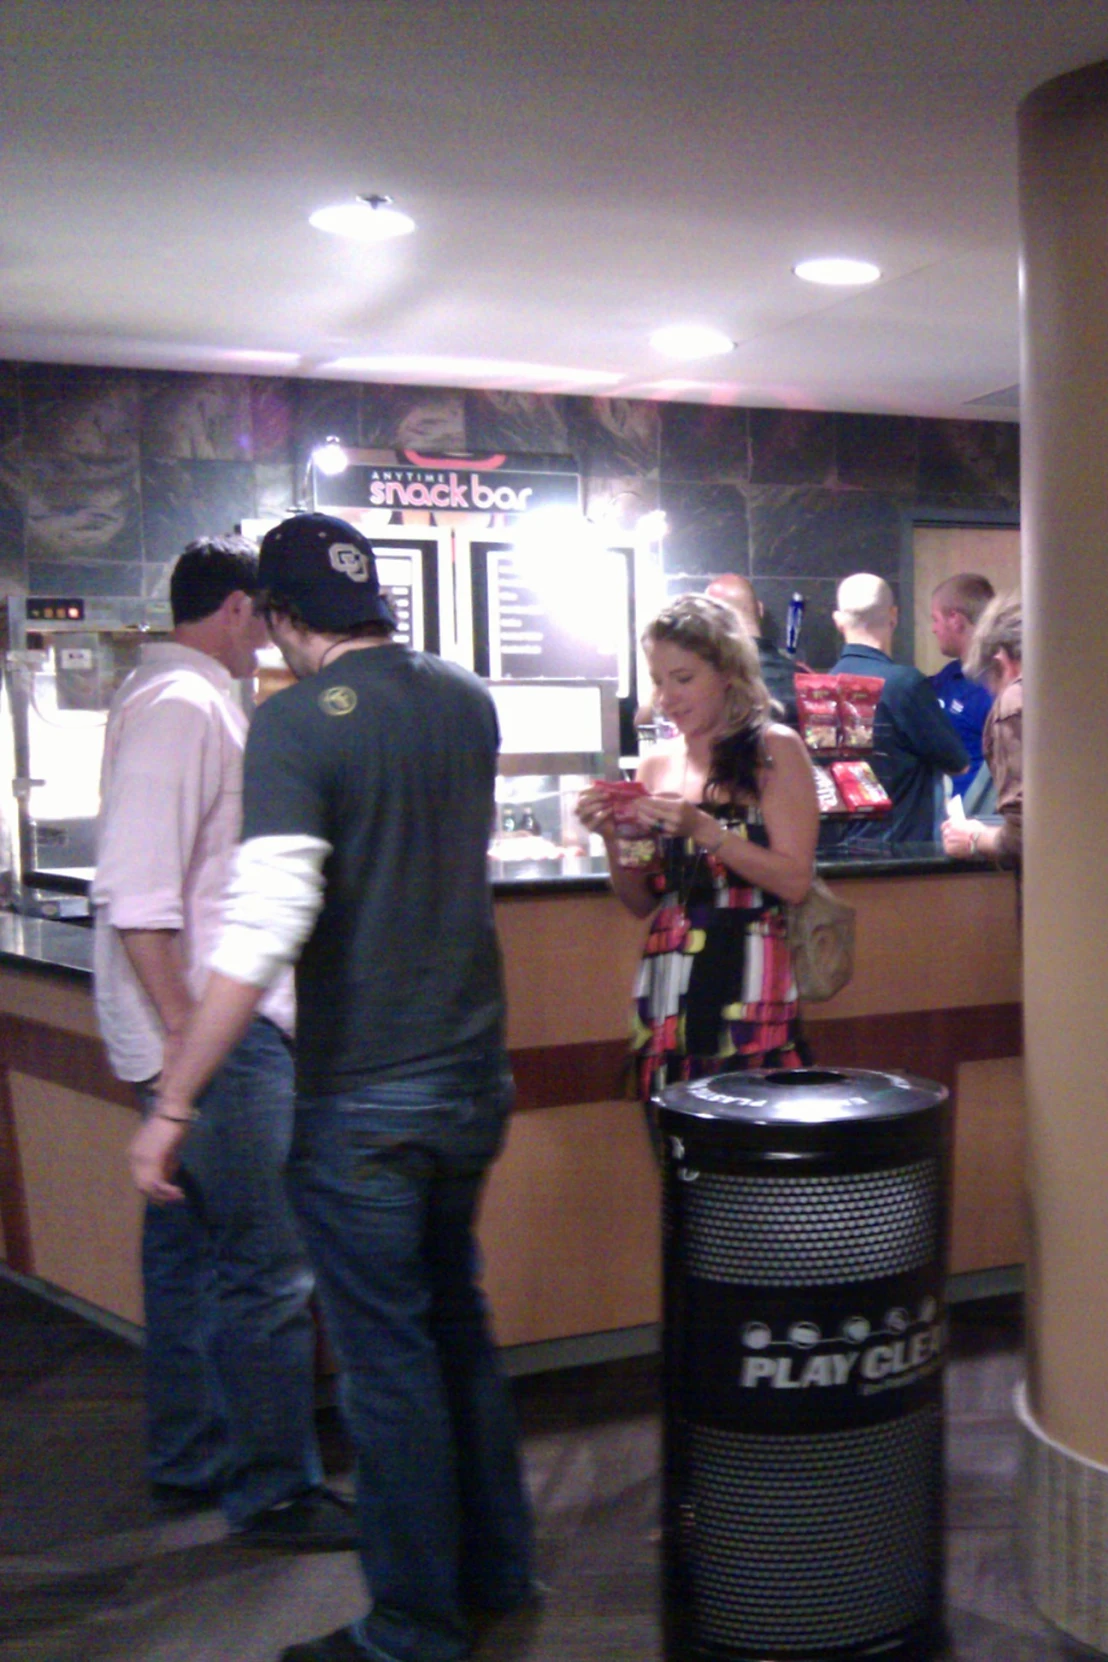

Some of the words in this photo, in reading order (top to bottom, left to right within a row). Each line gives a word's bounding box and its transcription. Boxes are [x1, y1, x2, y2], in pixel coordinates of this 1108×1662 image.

[370, 473, 470, 508] snack
[470, 474, 534, 511] bar
[371, 471, 445, 483] ANYTIME
[740, 1351, 859, 1389] PLAY
